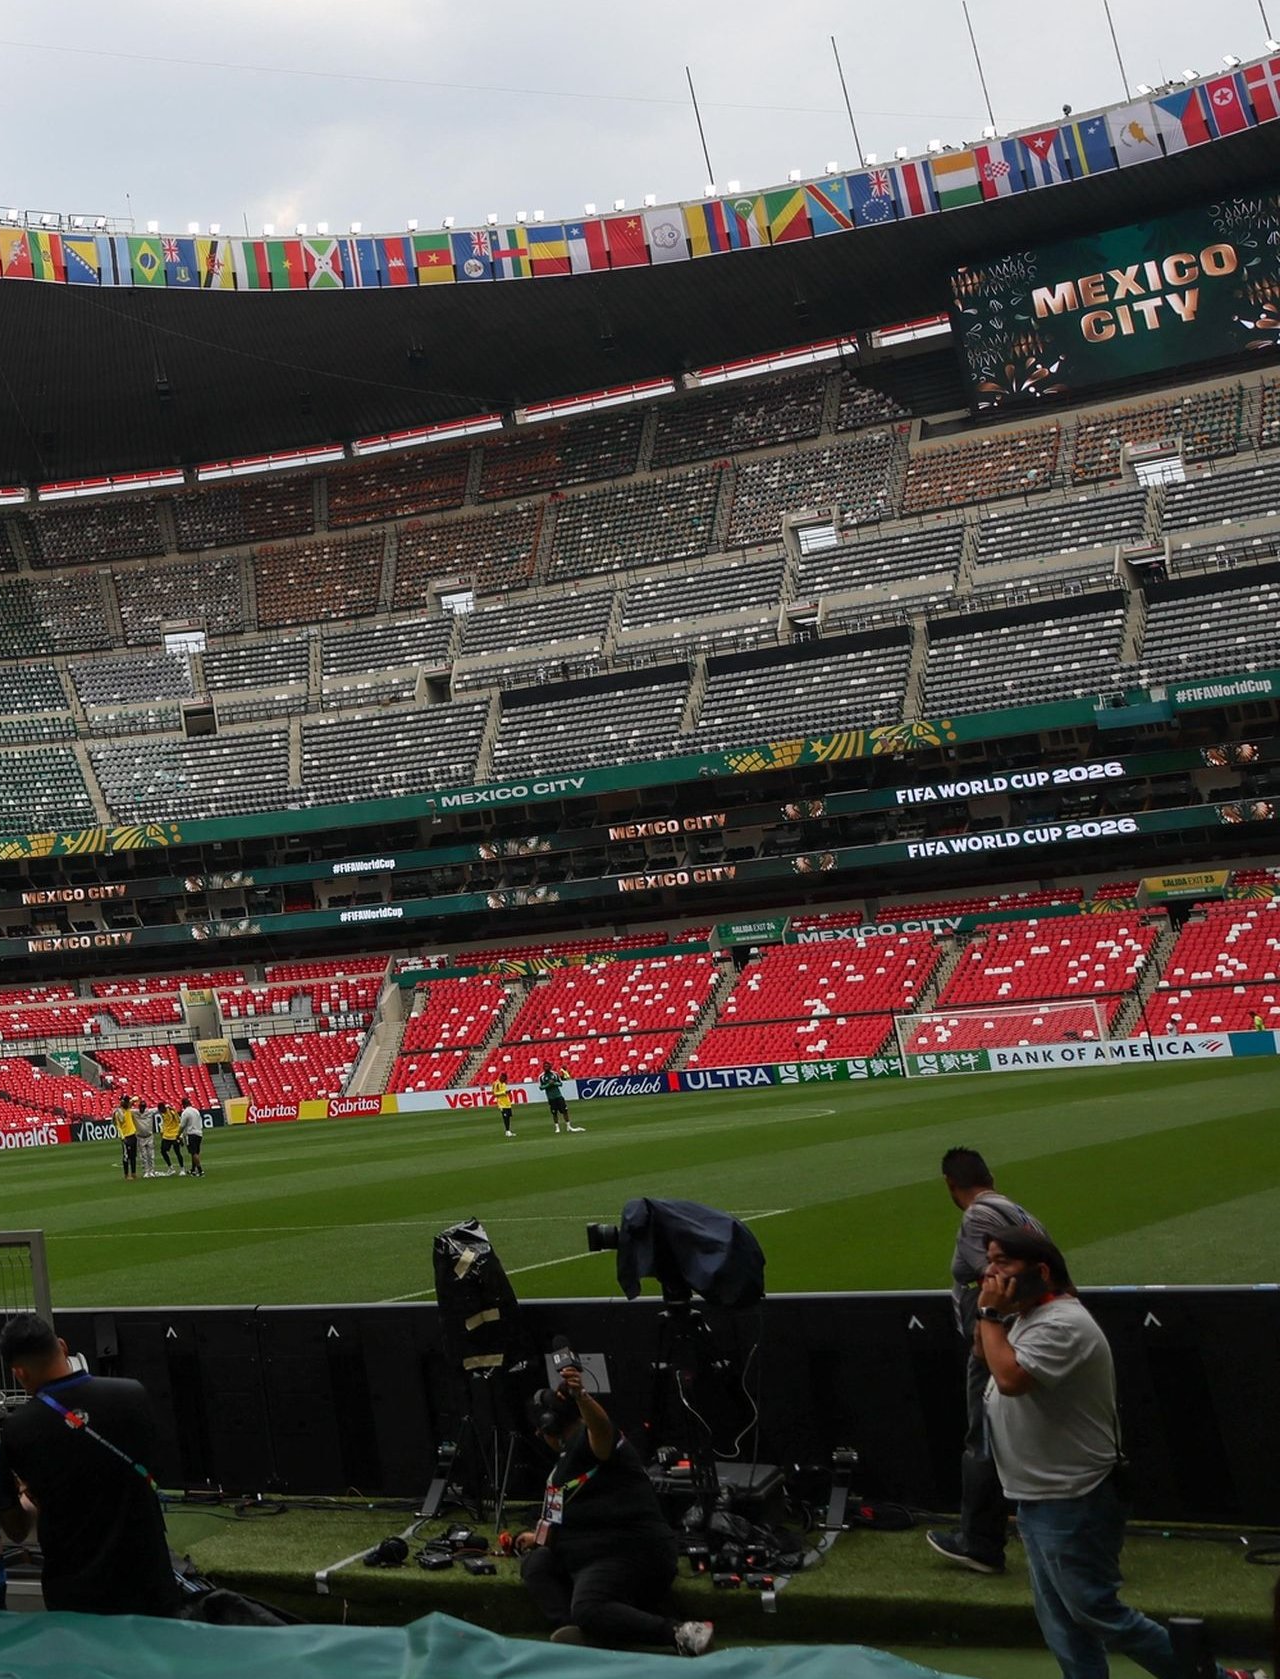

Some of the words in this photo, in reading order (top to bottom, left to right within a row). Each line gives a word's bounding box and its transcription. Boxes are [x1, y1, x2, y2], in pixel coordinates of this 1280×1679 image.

[1031, 243, 1238, 318] MEXICO
[1080, 287, 1199, 343] CITY
[1175, 680, 1272, 703] #FIFAWorldCup
[441, 785, 528, 807] MEXICO
[533, 777, 584, 794] CITY
[896, 786, 937, 803] FIFA
[938, 777, 1008, 799] WORLD
[1010, 771, 1049, 789] CUP
[1052, 762, 1125, 784] 2026
[608, 820, 679, 840] MEXICO
[683, 814, 726, 831] CITY
[907, 840, 949, 858] FIFA
[950, 831, 1020, 852] WORLD
[1023, 826, 1062, 844] CUP
[1065, 818, 1139, 840] 2026
[333, 859, 395, 874] #FIFAWorldCup
[618, 872, 689, 892] MEXICO
[693, 866, 736, 883] CITY
[1162, 878, 1187, 887] SALIDA
[1187, 876, 1204, 885] EXIT
[22, 888, 84, 904] MEXICO
[88, 885, 126, 899] CITY
[340, 907, 403, 922] #FIFAWorldCup
[753, 923, 765, 932] EXIT
[797, 924, 897, 944] MEXICO
[902, 917, 962, 935] CITY
[28, 936, 90, 952] MEXICO
[94, 932, 132, 947] CITY
[941, 1052, 980, 1072] 蒙牛
[996, 1049, 1054, 1067] BANK
[1061, 1047, 1086, 1062] OF
[1094, 1040, 1195, 1060] AMERICA
[800, 1062, 838, 1083] 蒙牛
[870, 1058, 902, 1077] 蒙牛
[581, 1072, 661, 1100] Michelob
[686, 1068, 771, 1091] ULTRA
[329, 1098, 380, 1117] Sabritas
[445, 1087, 528, 1109] verizn
[248, 1104, 297, 1123] Sabritas
